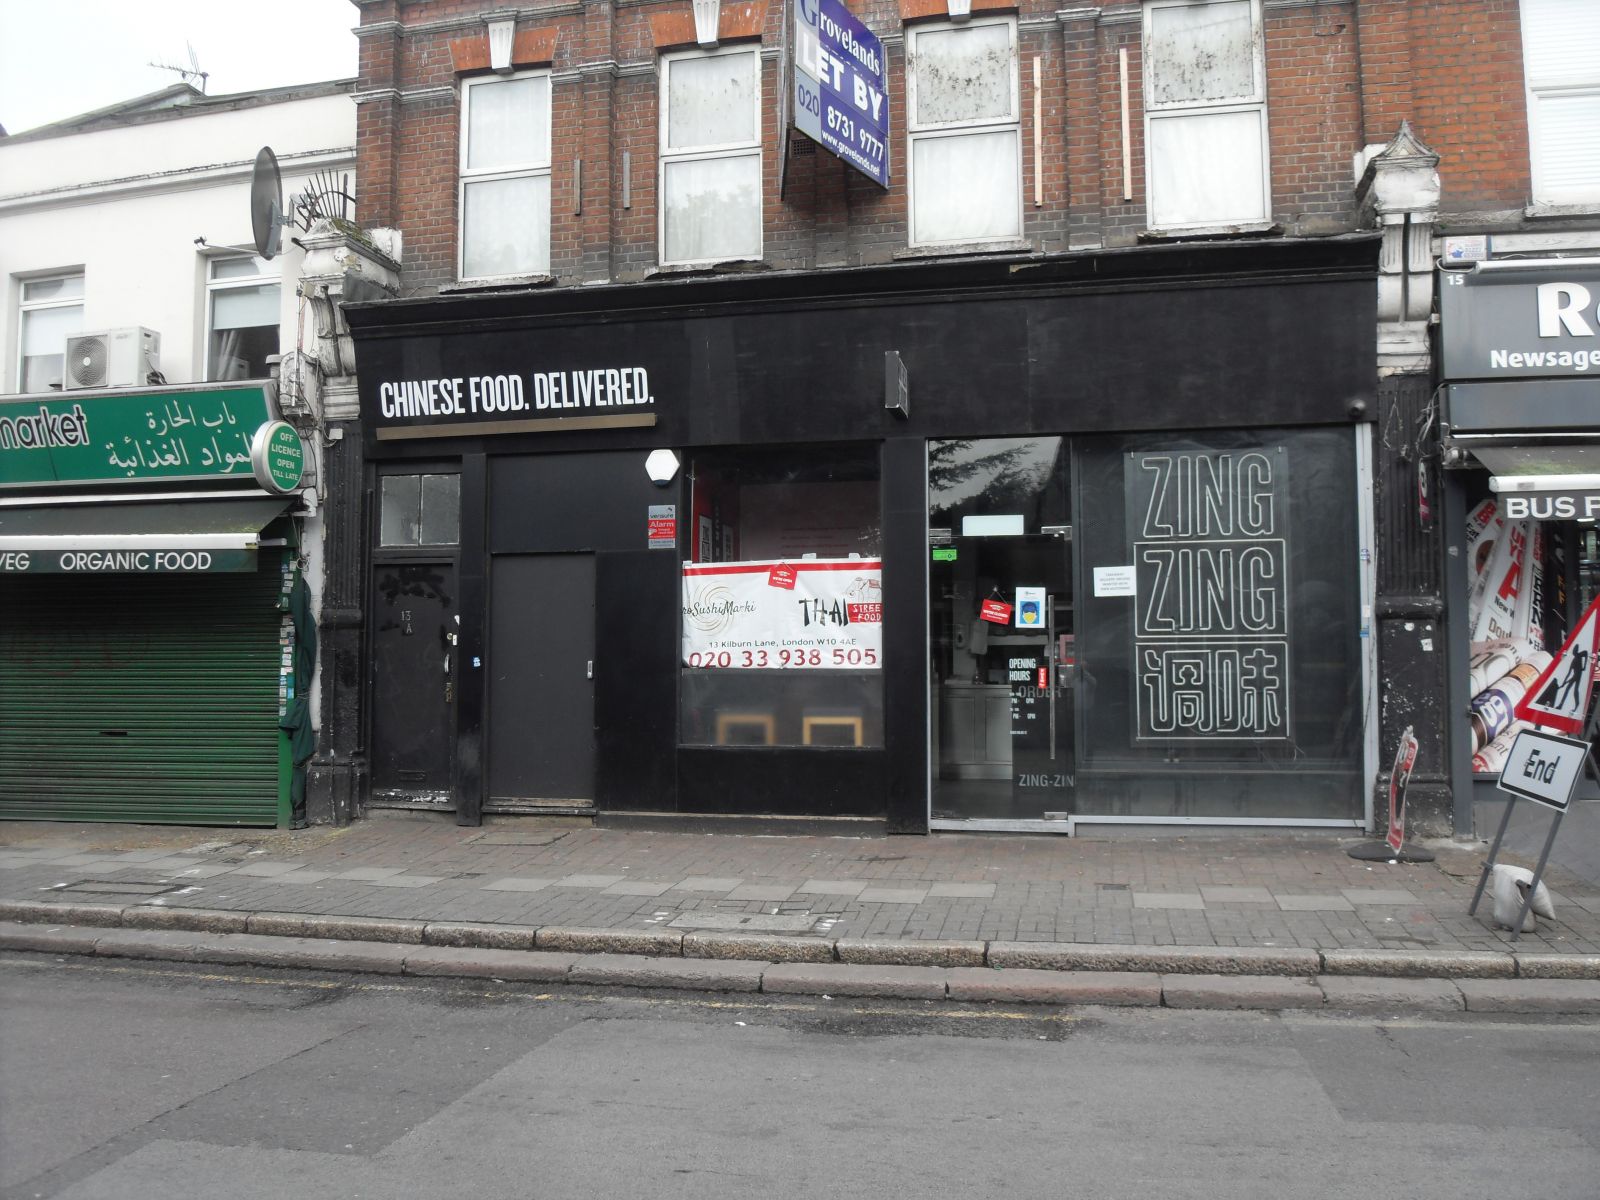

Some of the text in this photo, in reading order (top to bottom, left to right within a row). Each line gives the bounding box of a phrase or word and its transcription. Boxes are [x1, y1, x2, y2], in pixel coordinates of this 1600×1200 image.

[803, 31, 883, 122] LET BY
[798, 84, 884, 162] 020 8731 9777
[821, 129, 881, 177] www.grovelands.net
[1447, 274, 1465, 286] 15
[1536, 281, 1600, 338] R
[380, 367, 655, 418] CHINESE FOOD. DELIVERED.
[146, 400, 236, 436] باب الحارة
[271, 443, 301, 457] LICENCE
[280, 432, 294, 442] OFF
[105, 436, 190, 477] الغذائية
[276, 458, 295, 469] OPEN
[273, 469, 299, 481] TILL LATE
[1142, 453, 1274, 538] ZING
[1506, 496, 1576, 519] BUS
[60, 552, 149, 571] ORGANIC
[155, 551, 212, 570] FOOD
[1143, 547, 1276, 632] ZING
[798, 597, 849, 627] THAI
[857, 613, 882, 622] FOOD
[721, 640, 752, 648] Kilburn
[755, 639, 779, 647] Lane,
[782, 638, 814, 646] London
[688, 648, 877, 669] 020 33 938 505
[1009, 658, 1036, 669] OPENING
[1009, 670, 1031, 682] HOURS
[1143, 648, 1280, 733] 调味
[1522, 748, 1561, 785] End
